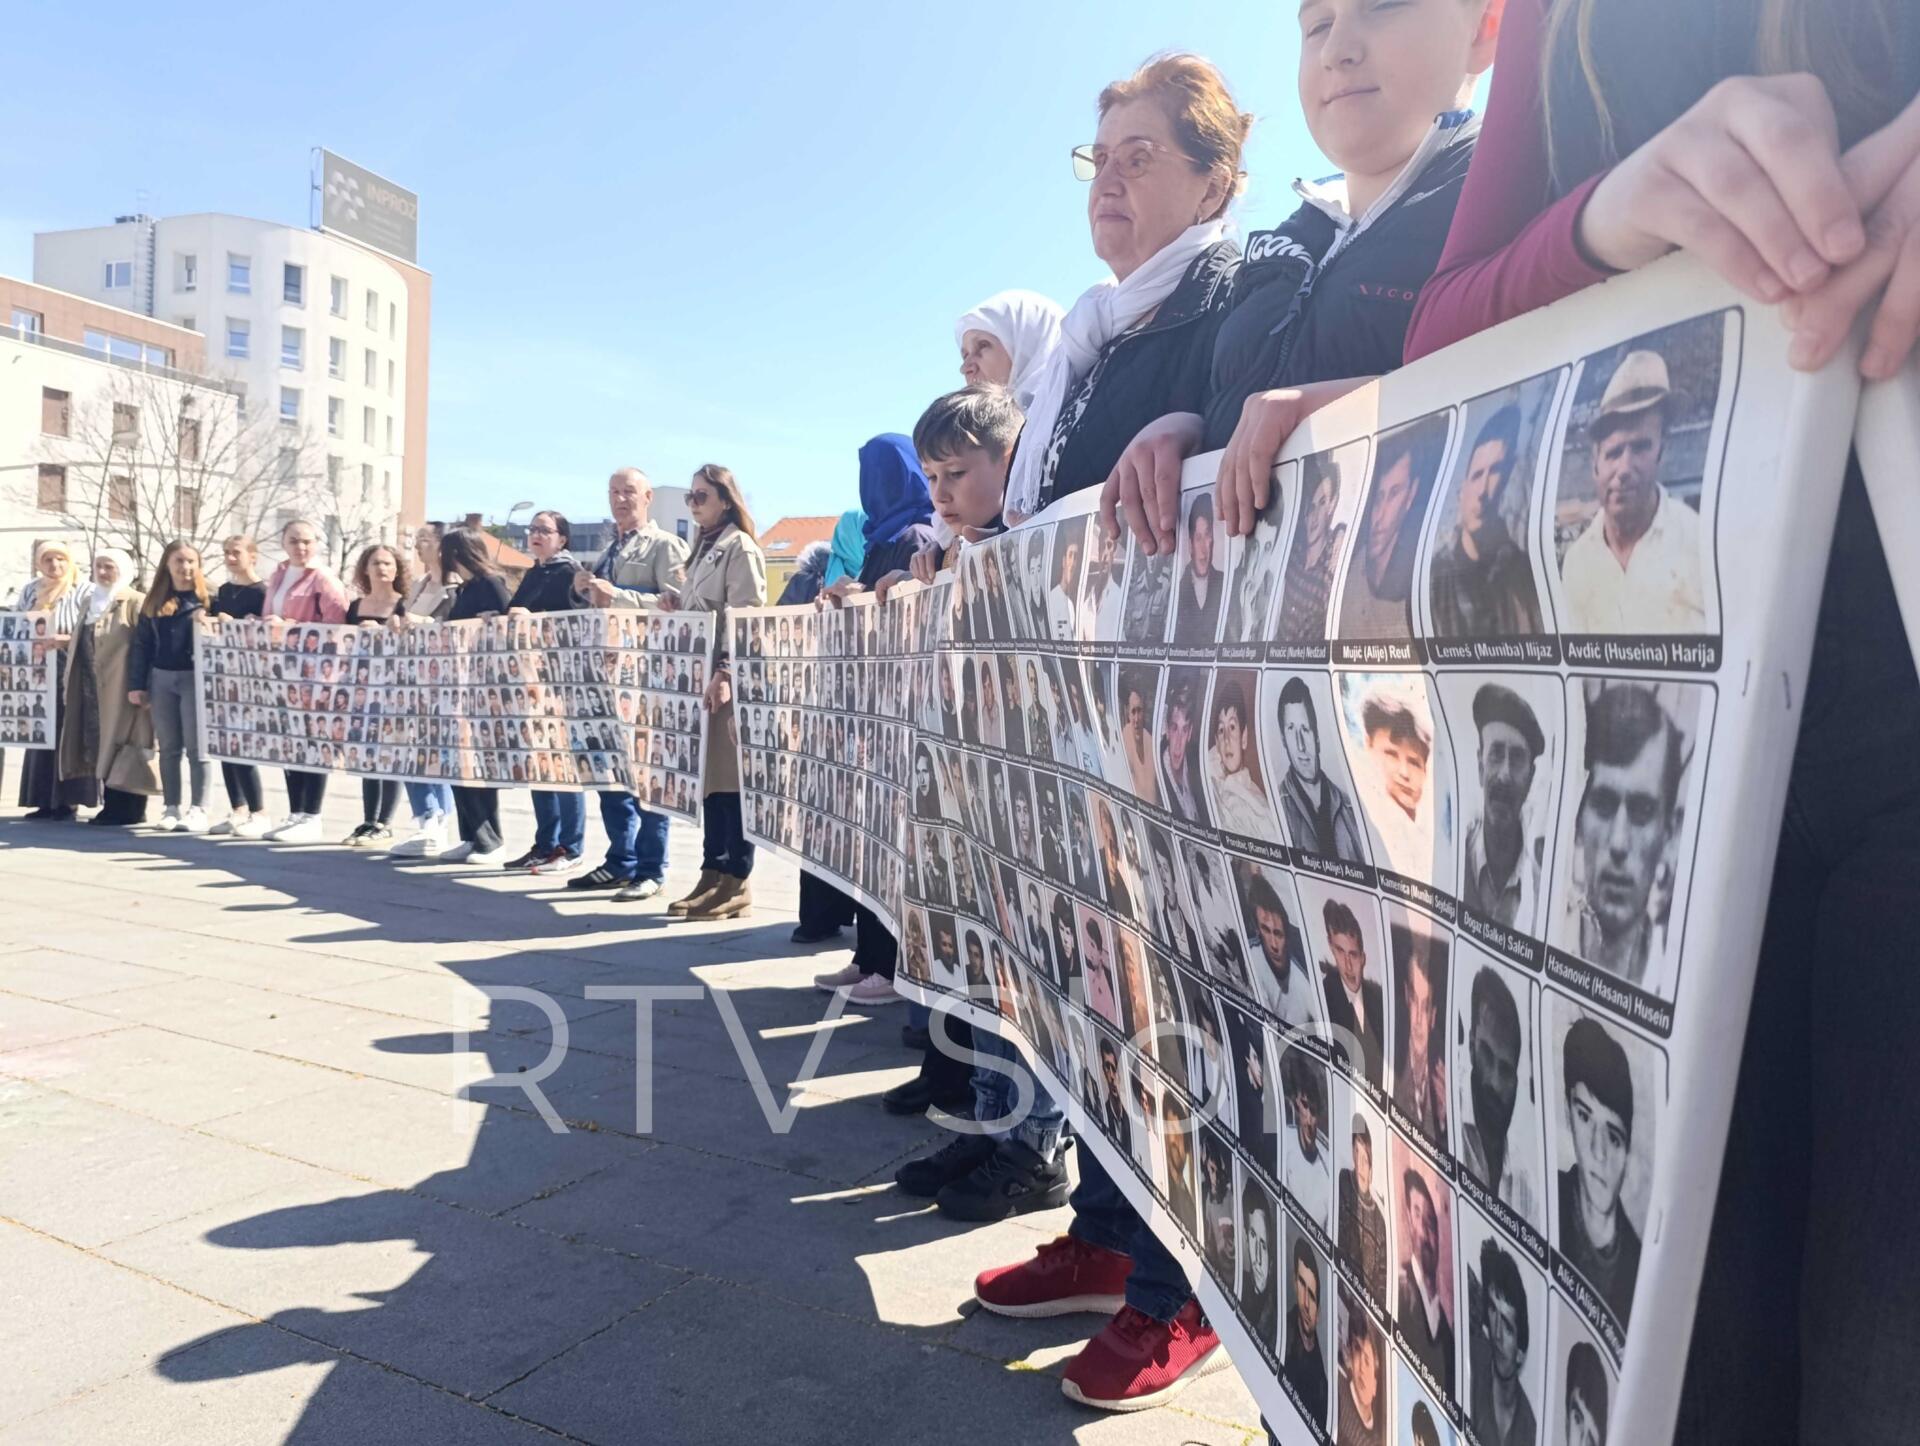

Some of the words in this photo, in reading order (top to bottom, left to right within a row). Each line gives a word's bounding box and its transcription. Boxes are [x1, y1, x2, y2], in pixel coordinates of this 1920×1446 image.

[1343, 645, 1363, 662] Mujić
[1364, 645, 1388, 662] (Alije)
[1389, 644, 1411, 659] Reuf
[1474, 642, 1525, 661] (Muniba)
[1568, 641, 1602, 660] Avdić
[1604, 641, 1668, 667] (Huseina)
[1672, 643, 1715, 669] Harija
[1345, 864, 1365, 880] Asim
[1483, 922, 1506, 950] (Salke)
[1547, 954, 1591, 989] Hasanović
[1591, 975, 1632, 1015] (Hasana)
[1634, 996, 1670, 1030] Husein
[1520, 1226, 1544, 1259] Salko
[1575, 1282, 1600, 1327] (Alije)
